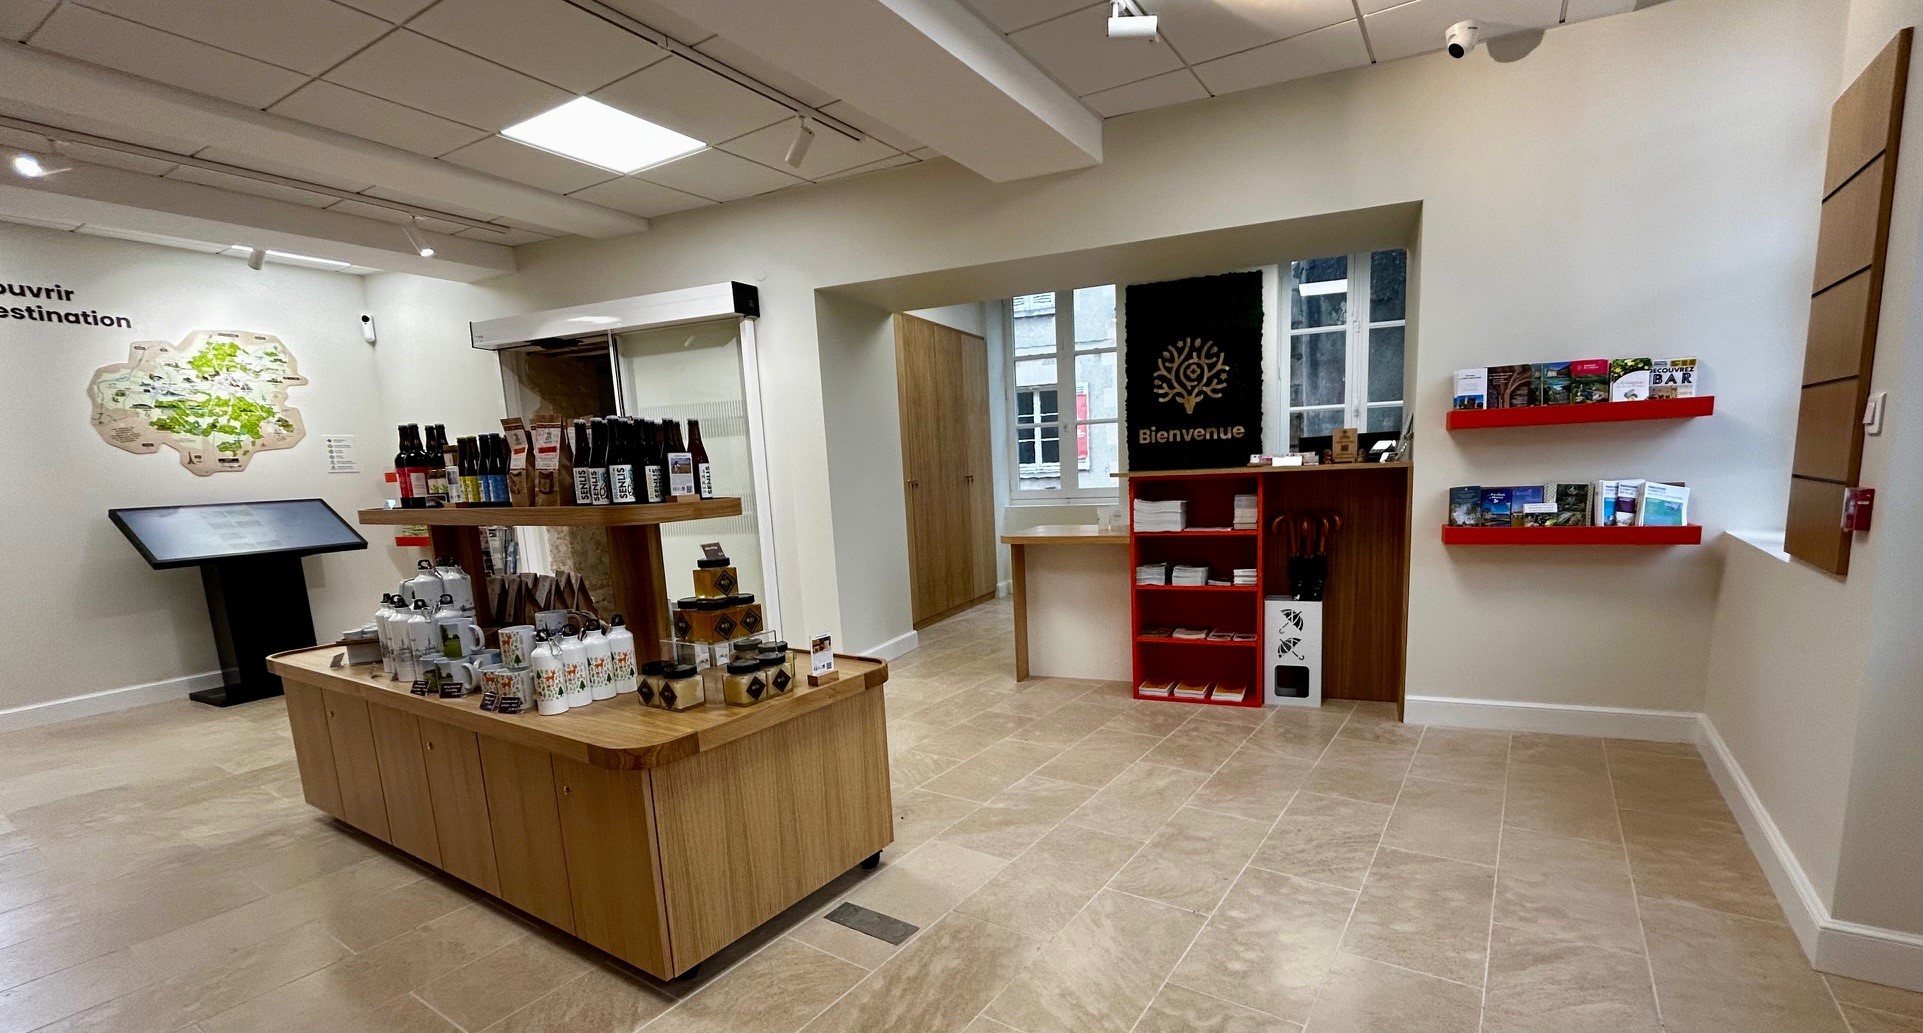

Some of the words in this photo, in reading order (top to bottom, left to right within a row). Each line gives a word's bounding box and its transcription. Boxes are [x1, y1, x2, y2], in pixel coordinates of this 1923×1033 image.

[1653, 373, 1692, 384] BAR
[1139, 425, 1245, 444] Bienvenue
[578, 470, 589, 500] SENLIS
[591, 471, 600, 501] SENLIS
[617, 467, 628, 499] SENLIS
